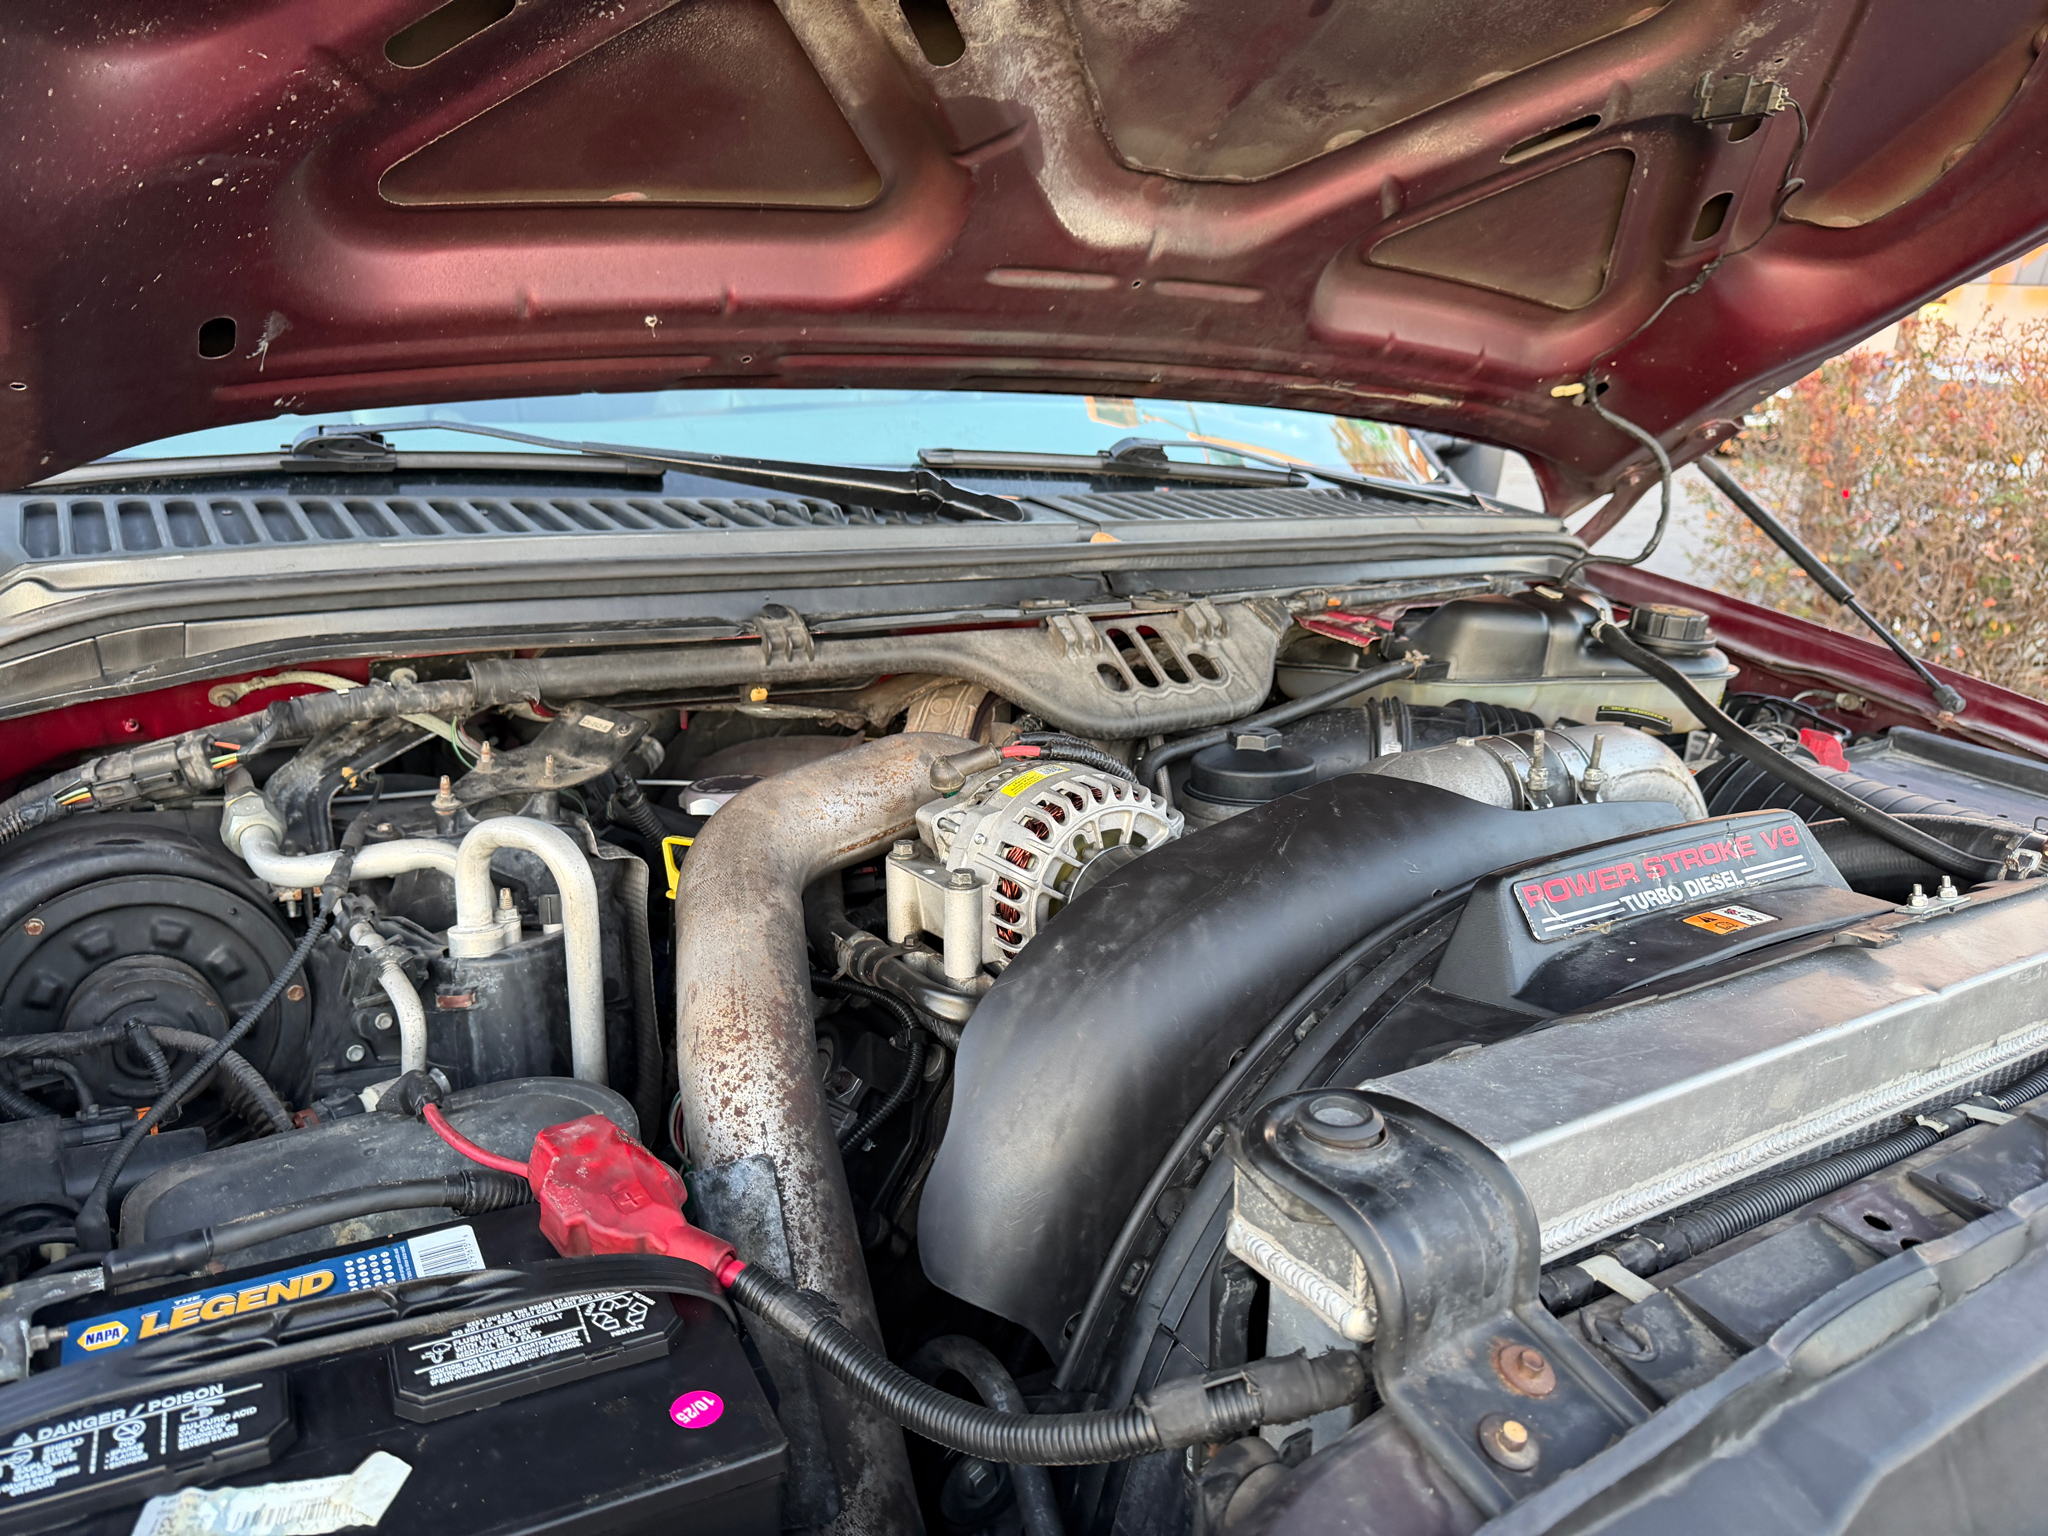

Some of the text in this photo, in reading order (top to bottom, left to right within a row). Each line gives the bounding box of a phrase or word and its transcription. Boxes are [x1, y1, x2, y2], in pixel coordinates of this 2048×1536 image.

[1521, 825, 1800, 908] POWER STROKE V8
[1619, 869, 1745, 912] TURBO DIESEL
[138, 1269, 336, 1340] LEGEND
[174, 1294, 201, 1306] THE
[464, 1325, 480, 1334] NOT
[497, 1316, 515, 1325] KEEP
[515, 1309, 534, 1319] VENT
[536, 1305, 555, 1315] CAPS
[556, 1300, 577, 1311] TIGHT
[578, 1295, 592, 1303] AND
[466, 1318, 485, 1328] KEEP
[486, 1315, 501, 1323] OUT
[502, 1311, 513, 1319] OF
[513, 1307, 528, 1316] THE
[528, 1300, 552, 1313] REACH
[85, 1327, 121, 1345] NAPA
[452, 1312, 563, 1347] FLUSH EYES IMMEDIATELY
[454, 1341, 478, 1353] WITH
[515, 1327, 532, 1337] GET
[610, 1323, 645, 1337] RECYCLE
[429, 1331, 579, 1375] CAUTION: FOR SAFE JUMP STARTING FOLLOW
[456, 1330, 542, 1359] MEDICAL HELP FAST
[430, 1365, 481, 1380] INSTRUCTIONS
[481, 1361, 490, 1369] IN
[490, 1353, 519, 1367] VEHICLE
[430, 1378, 438, 1387] IF
[439, 1375, 454, 1385] NOT
[455, 1366, 492, 1380] AVAILABLE
[493, 1360, 511, 1371] SEEK
[511, 1351, 539, 1365] SERVICE
[37, 1408, 126, 1441] DANGER
[147, 1383, 223, 1413] POISON
[178, 1406, 258, 1432] SULFURIC ACID
[675, 1396, 715, 1424] 10/25
[178, 1422, 238, 1444] BLINDNESS OR
[199, 1421, 226, 1433] CAUSE
[43, 1437, 84, 1453] SHIELD
[109, 1449, 143, 1463] FLAMES
[110, 1442, 144, 1456] SPARKS
[119, 1439, 136, 1449] NO
[109, 1453, 149, 1469] SMOKING
